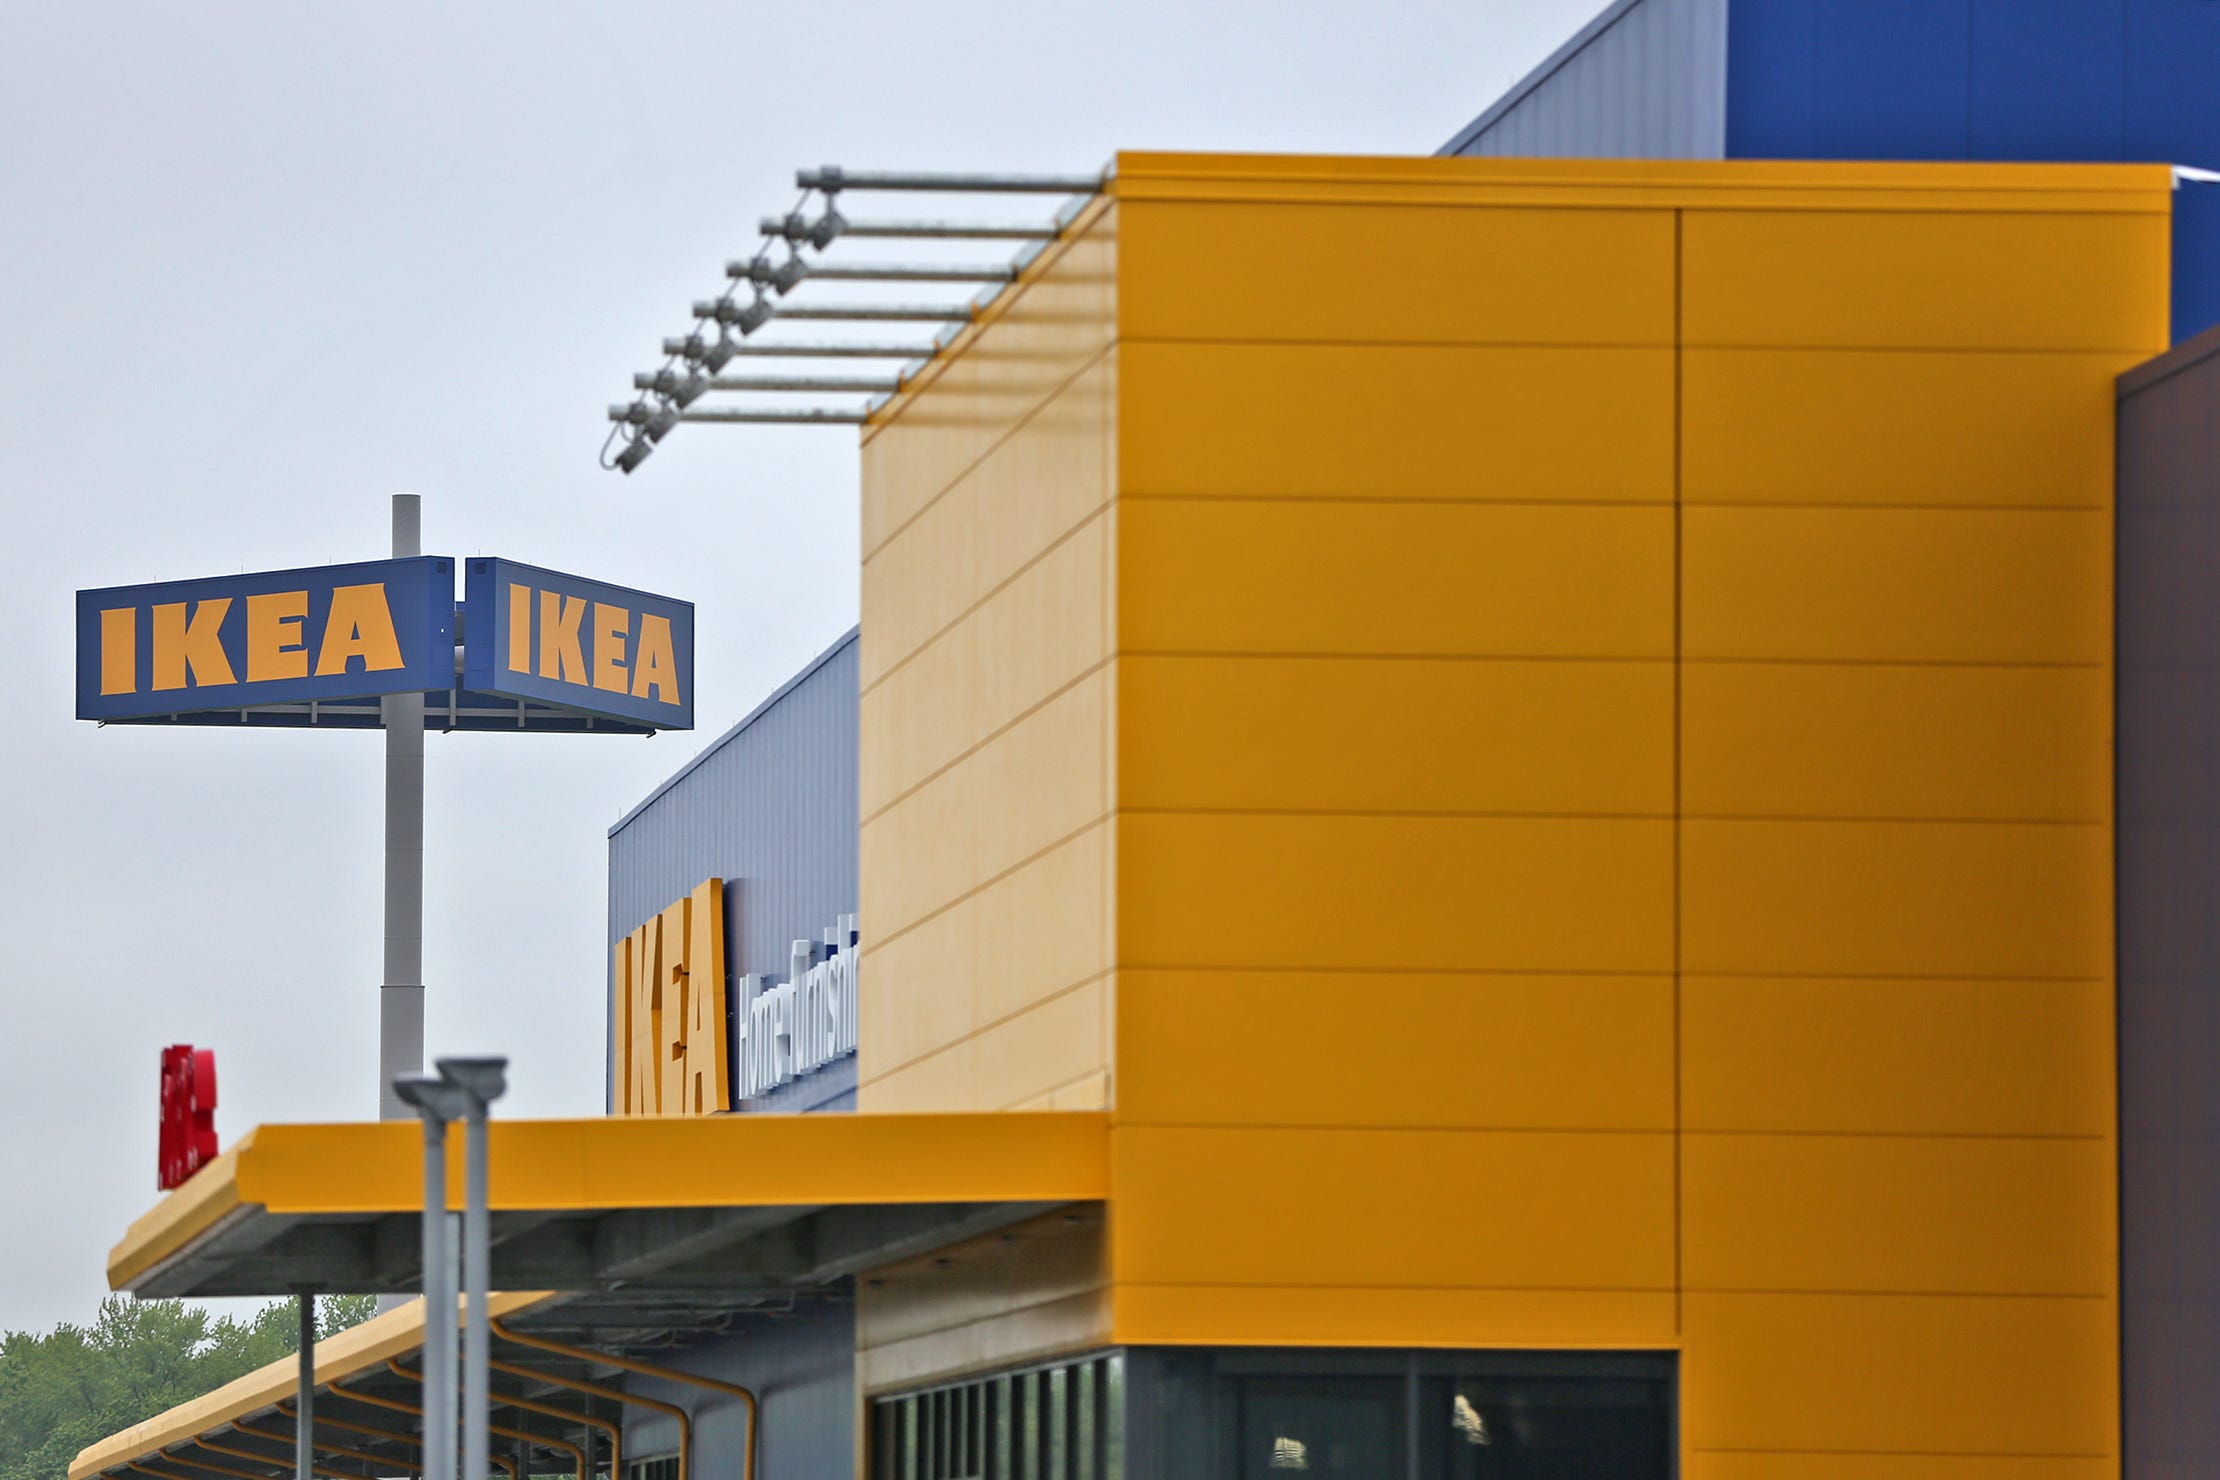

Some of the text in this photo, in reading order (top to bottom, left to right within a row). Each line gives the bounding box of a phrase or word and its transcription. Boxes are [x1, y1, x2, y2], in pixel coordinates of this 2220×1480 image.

[100, 582, 406, 696] IKEA
[509, 582, 681, 706] IKEA
[614, 877, 730, 1117] IKEA
[739, 973, 791, 1100] Home
